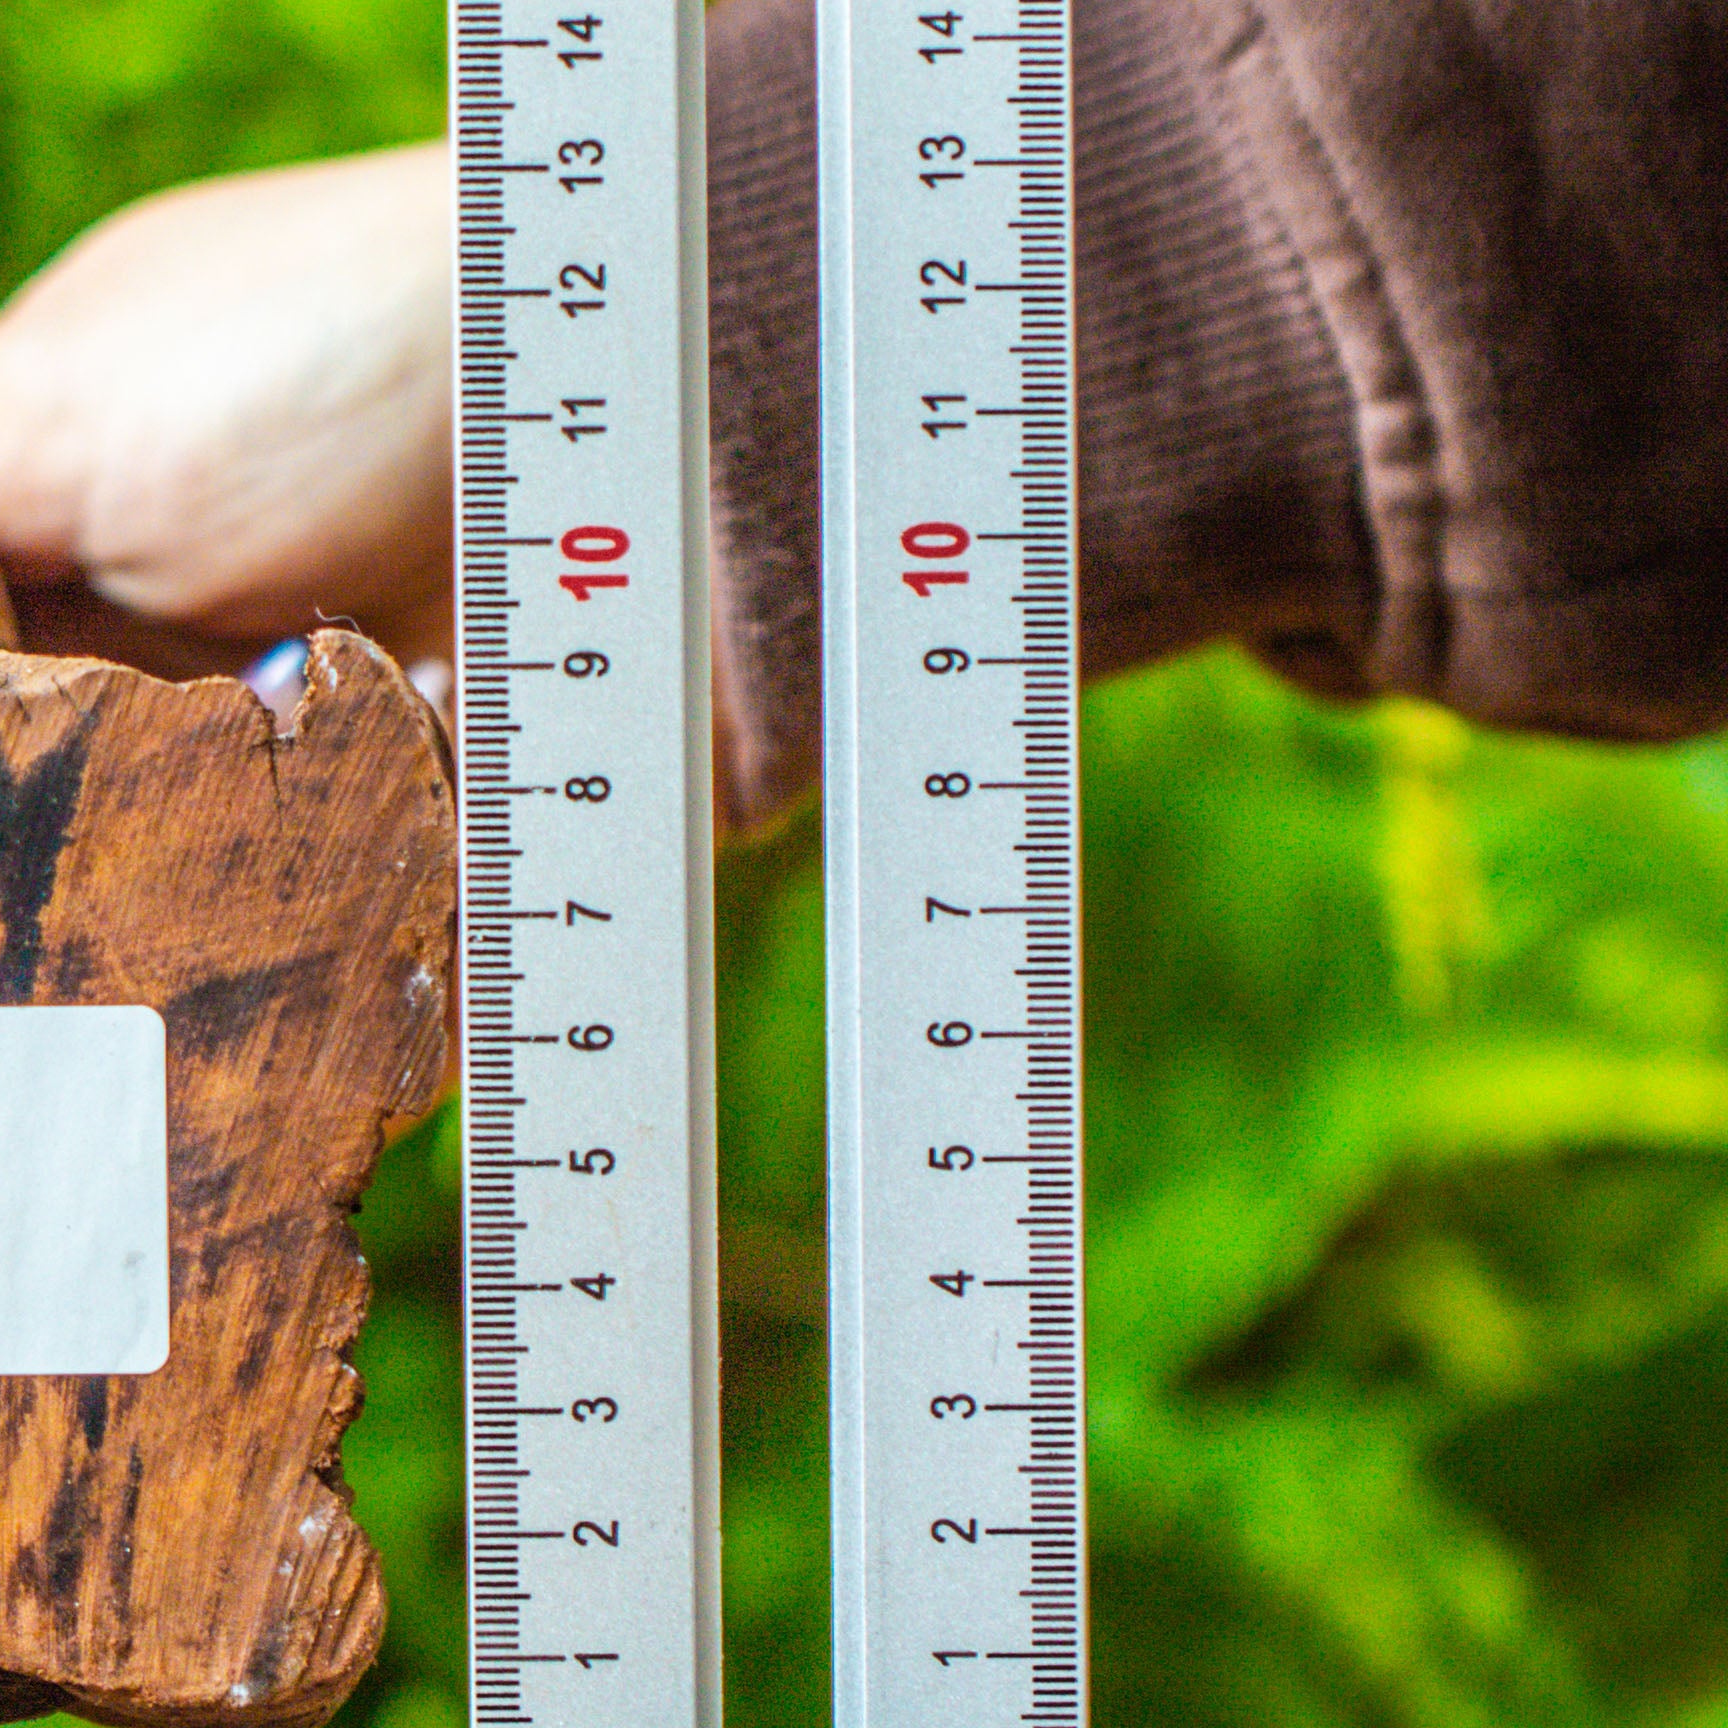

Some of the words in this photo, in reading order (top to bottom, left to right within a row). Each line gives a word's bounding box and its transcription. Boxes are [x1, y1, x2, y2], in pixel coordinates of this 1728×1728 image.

[557, 14, 603, 70] 14
[918, 11, 964, 64] 14
[558, 139, 605, 194] 13
[918, 135, 965, 189] 13
[558, 264, 606, 318] 12
[920, 260, 966, 314] 12
[560, 398, 607, 443] 11
[921, 395, 967, 439] 11
[558, 525, 630, 602] 10
[900, 521, 970, 597] 10
[563, 651, 610, 679] 9
[923, 647, 970, 675] 9
[564, 775, 612, 804] 8
[924, 772, 971, 798] 8
[566, 900, 612, 926] 7
[925, 896, 971, 923] 7
[567, 1024, 614, 1052] 6
[926, 1021, 973, 1048] 6
[569, 1148, 616, 1176] 5
[928, 1145, 974, 1171] 5
[570, 1273, 616, 1301] 4
[929, 1270, 975, 1298] 4
[571, 1397, 618, 1423] 3
[930, 1393, 977, 1420] 3
[572, 1520, 619, 1547] 2
[930, 1518, 977, 1544] 2
[574, 1653, 619, 1669] 1
[932, 1651, 978, 1666] 1
